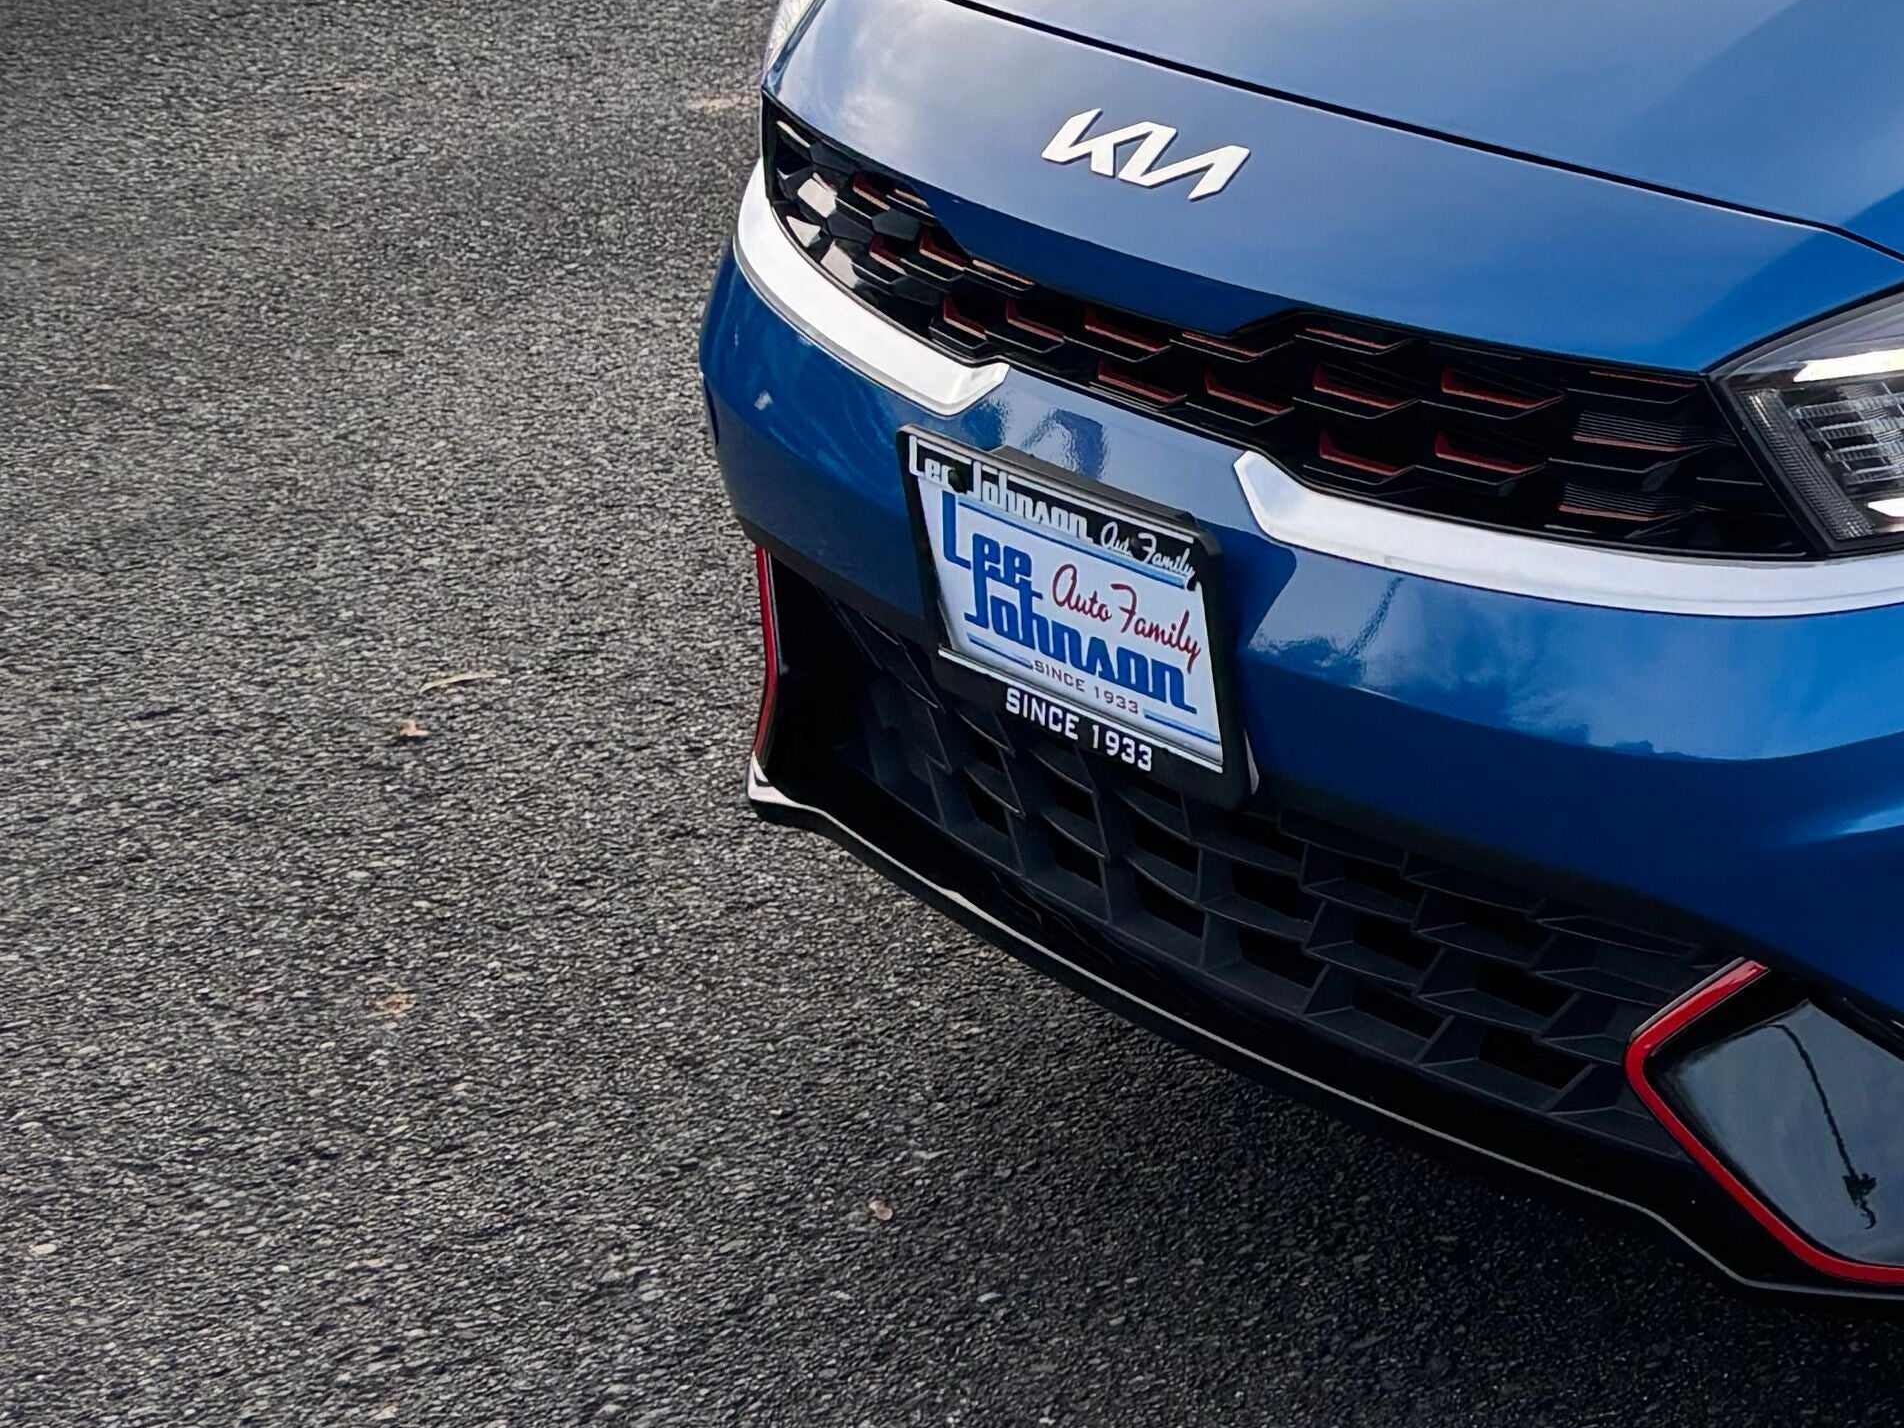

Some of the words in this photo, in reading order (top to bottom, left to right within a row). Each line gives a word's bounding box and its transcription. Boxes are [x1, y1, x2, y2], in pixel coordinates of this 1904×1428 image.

[1041, 107, 1251, 202] KIA
[941, 490, 1043, 600] Lee
[966, 460, 1095, 544] Johnson
[1138, 532, 1196, 591] Family
[964, 572, 1198, 715] Johnson
[1052, 563, 1112, 622] Auto
[1110, 583, 1202, 675] Family
[1004, 687, 1080, 741] SINCE
[1091, 724, 1154, 772] 1933
[1033, 659, 1086, 693] SINCE
[1094, 685, 1140, 715] 1933
